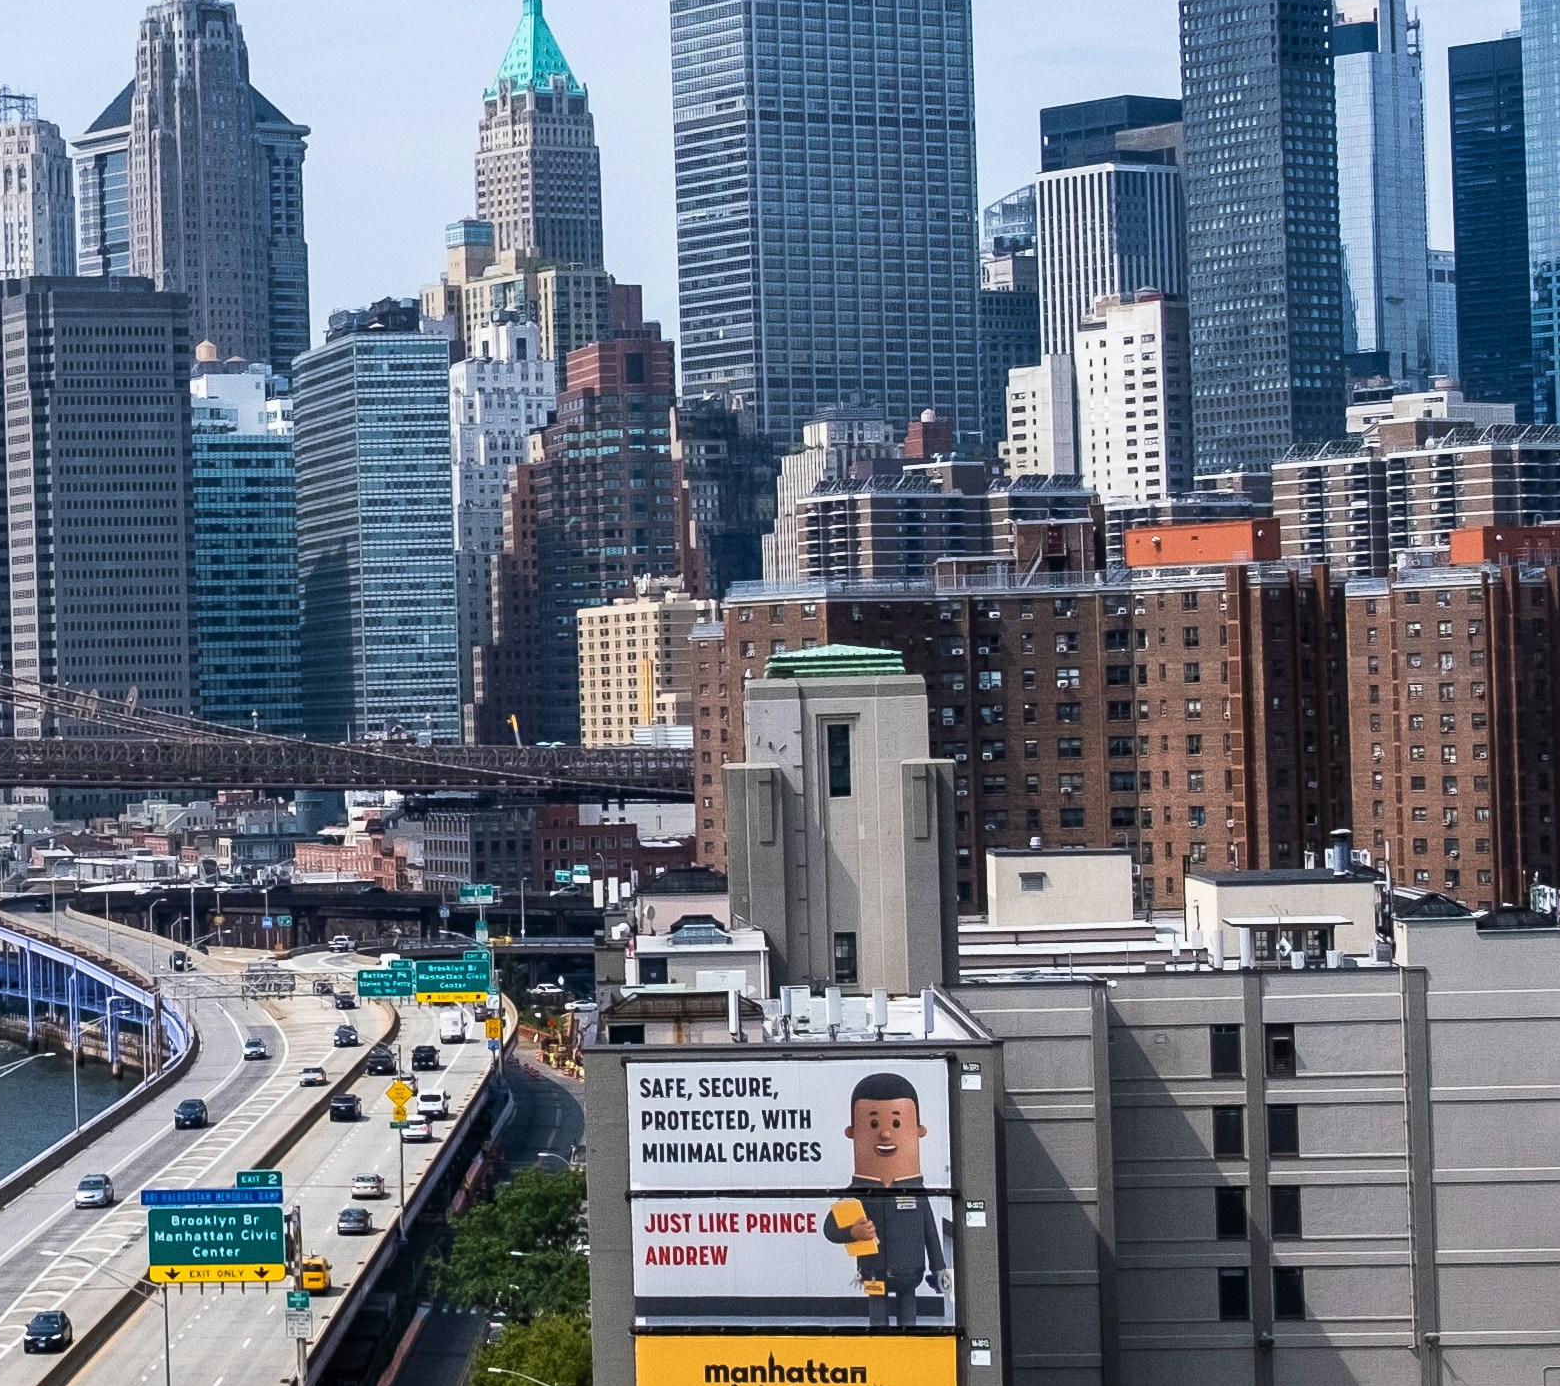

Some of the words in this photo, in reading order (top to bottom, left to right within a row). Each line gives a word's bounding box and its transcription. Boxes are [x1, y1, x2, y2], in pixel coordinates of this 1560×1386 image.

[427, 964, 465, 973] Brooklyn
[639, 1077, 693, 1102] SAFE,
[698, 1076, 779, 1100] SECURE,
[641, 1109, 756, 1133] PROTECTED,
[761, 1109, 812, 1130] WITH
[642, 1142, 728, 1164] MINIMAL
[732, 1141, 823, 1163] CHARGES
[241, 1175, 260, 1184] EXIT
[267, 1173, 278, 1185] 2
[215, 1192, 254, 1202] MEMORIAL
[258, 1191, 280, 1201] RAMP
[171, 1215, 237, 1228] Brooklyn
[243, 1214, 260, 1225] Br
[644, 1213, 692, 1234] JUST
[698, 1212, 740, 1233] LIKE
[746, 1212, 818, 1234] PRINCE
[154, 1230, 234, 1242] Manhattan
[240, 1229, 278, 1241] Civic
[192, 1246, 241, 1258] Center
[645, 1245, 729, 1266] ANDREW
[189, 1269, 211, 1279] EXIT
[216, 1269, 245, 1279] ONLY
[704, 1351, 867, 1384] manhattan
